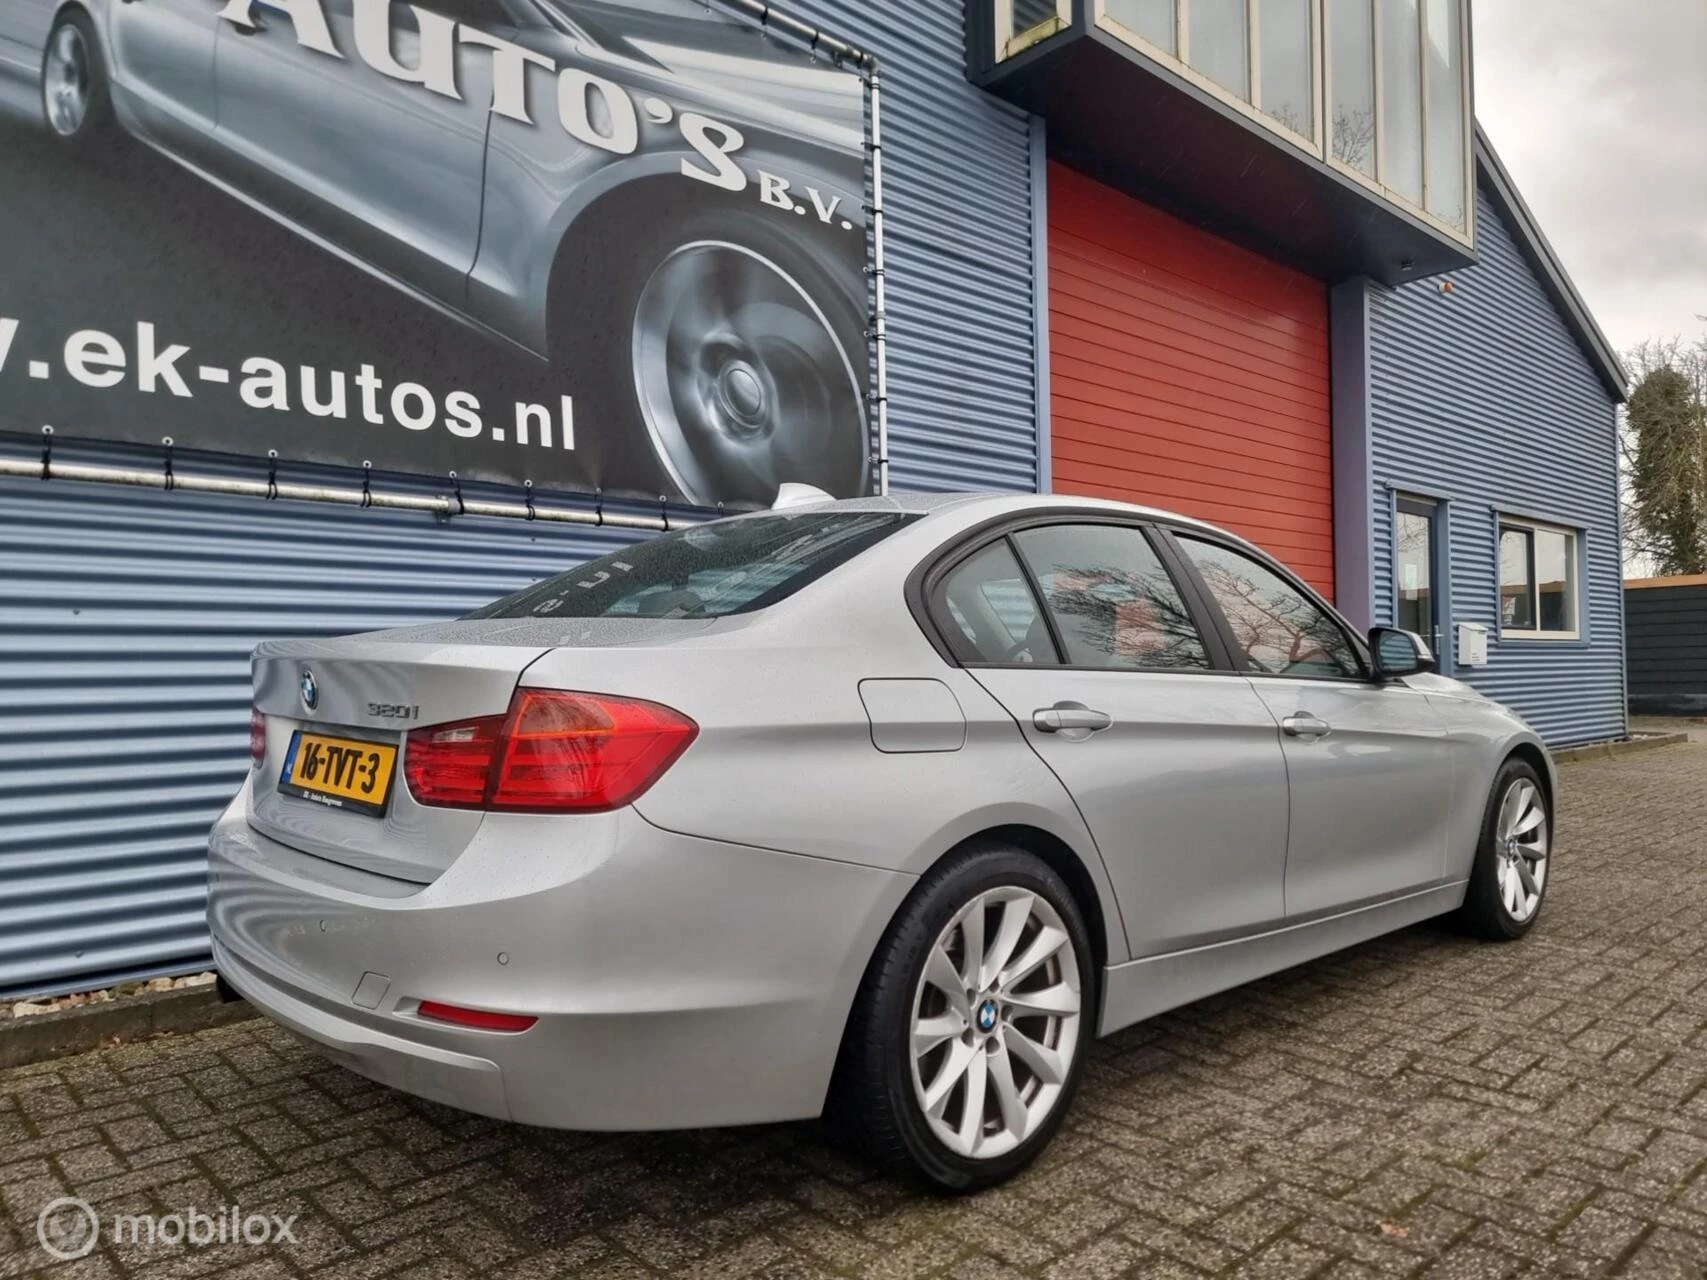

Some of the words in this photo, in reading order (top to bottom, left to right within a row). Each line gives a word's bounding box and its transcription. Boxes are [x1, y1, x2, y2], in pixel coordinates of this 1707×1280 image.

[757, 169, 853, 230] B.V.
[0, 317, 576, 450] .ek-autos.nl
[367, 703, 420, 720] 320i
[300, 742, 380, 794] 16-TVT-3
